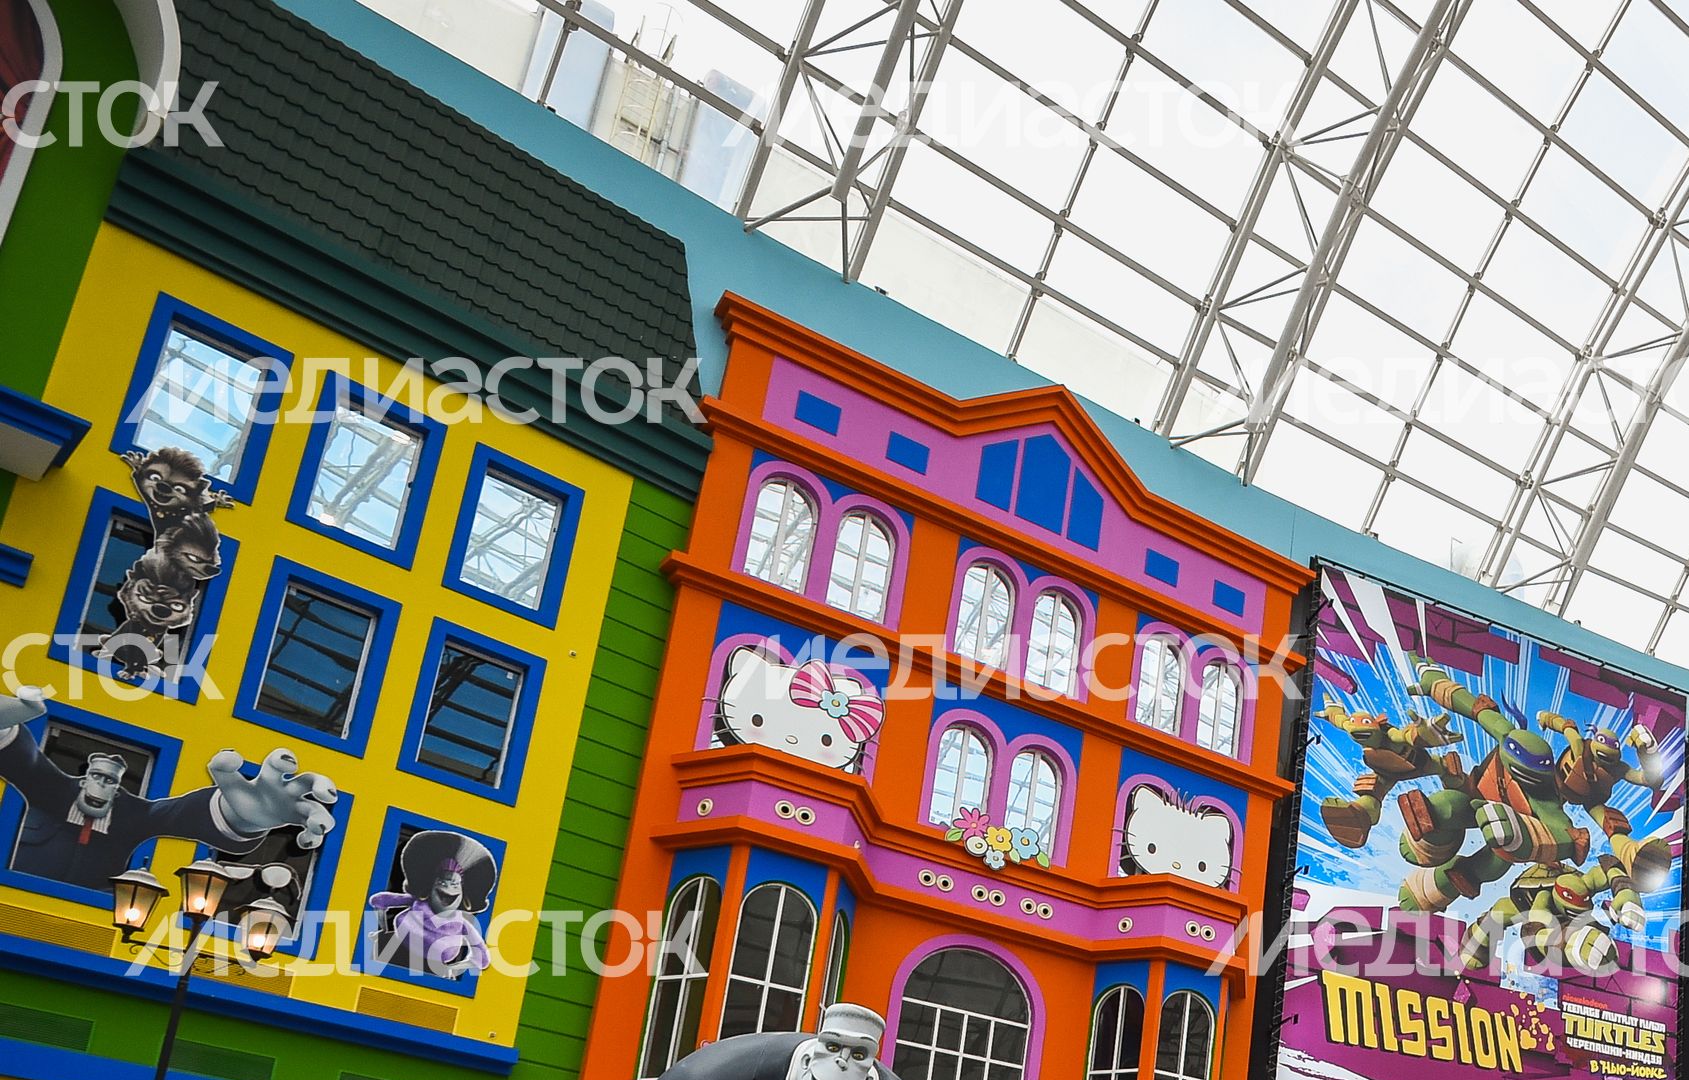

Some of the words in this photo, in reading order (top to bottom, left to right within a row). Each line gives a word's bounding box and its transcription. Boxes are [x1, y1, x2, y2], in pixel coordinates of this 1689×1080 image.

[1562, 993, 1608, 1010] nickelodeon
[1320, 969, 1523, 1073] MISSION
[1562, 1012, 1666, 1055] TURTLES
[1601, 1011, 1638, 1027] MUTANT
